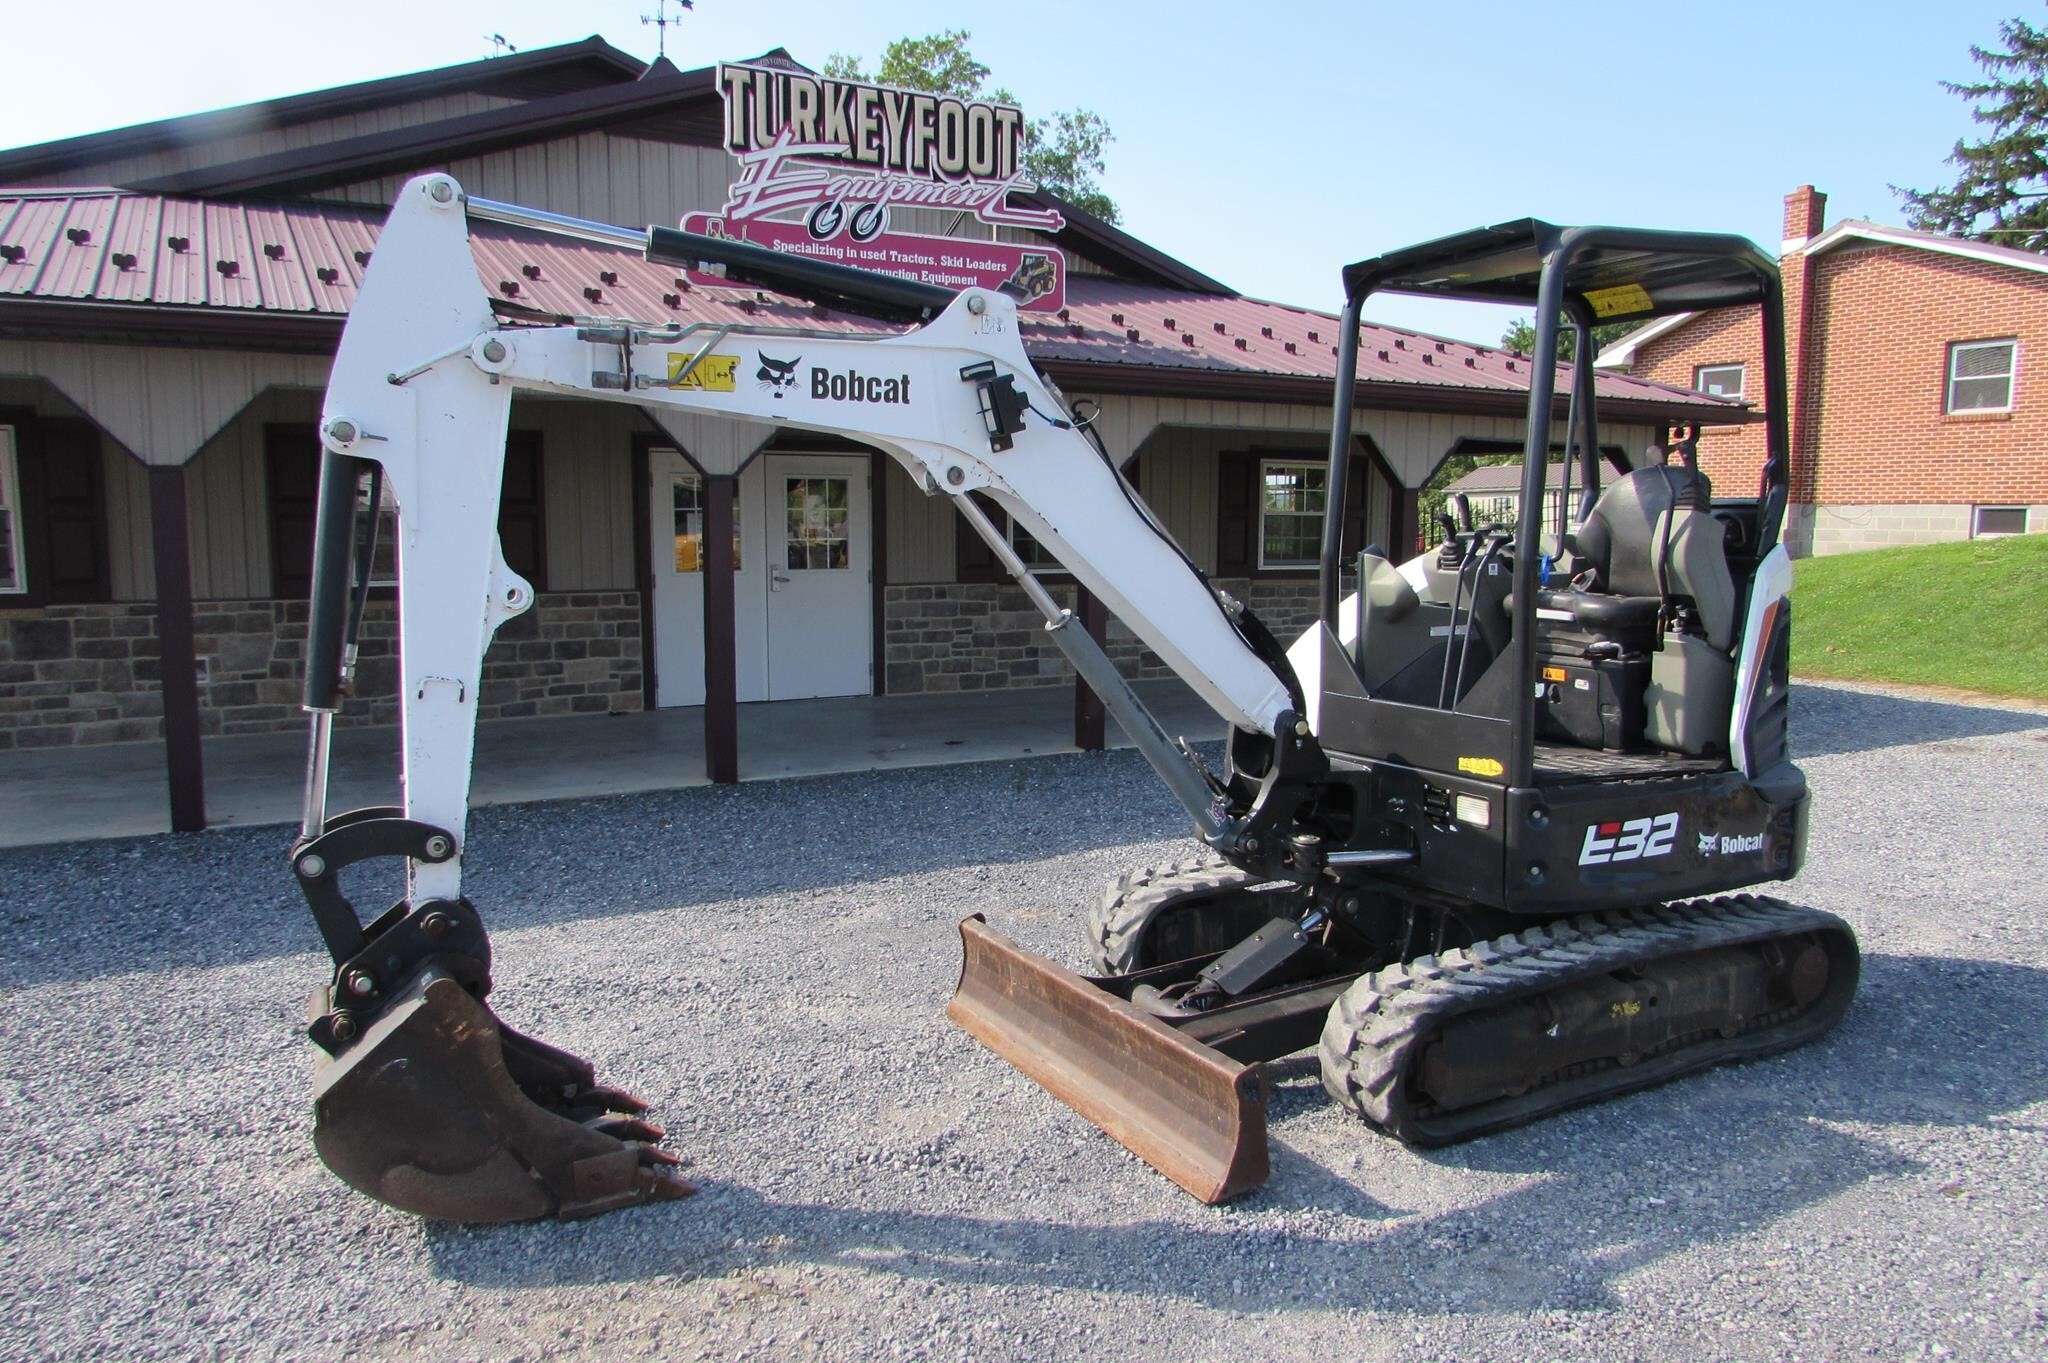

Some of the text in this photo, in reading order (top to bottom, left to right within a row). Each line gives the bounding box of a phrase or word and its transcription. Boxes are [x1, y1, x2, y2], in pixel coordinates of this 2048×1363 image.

[724, 68, 1018, 177] TURKEYFOOT
[730, 126, 1057, 233] Equipment
[773, 239, 843, 260] Specializing
[846, 246, 857, 258] in
[860, 249, 886, 261] used
[940, 255, 963, 268] Skid
[966, 258, 1007, 272] Loaders
[921, 270, 978, 286] Equipment
[811, 366, 911, 405] Bobcat
[1578, 812, 1680, 866] E32
[1720, 832, 1763, 855] Bobcat
